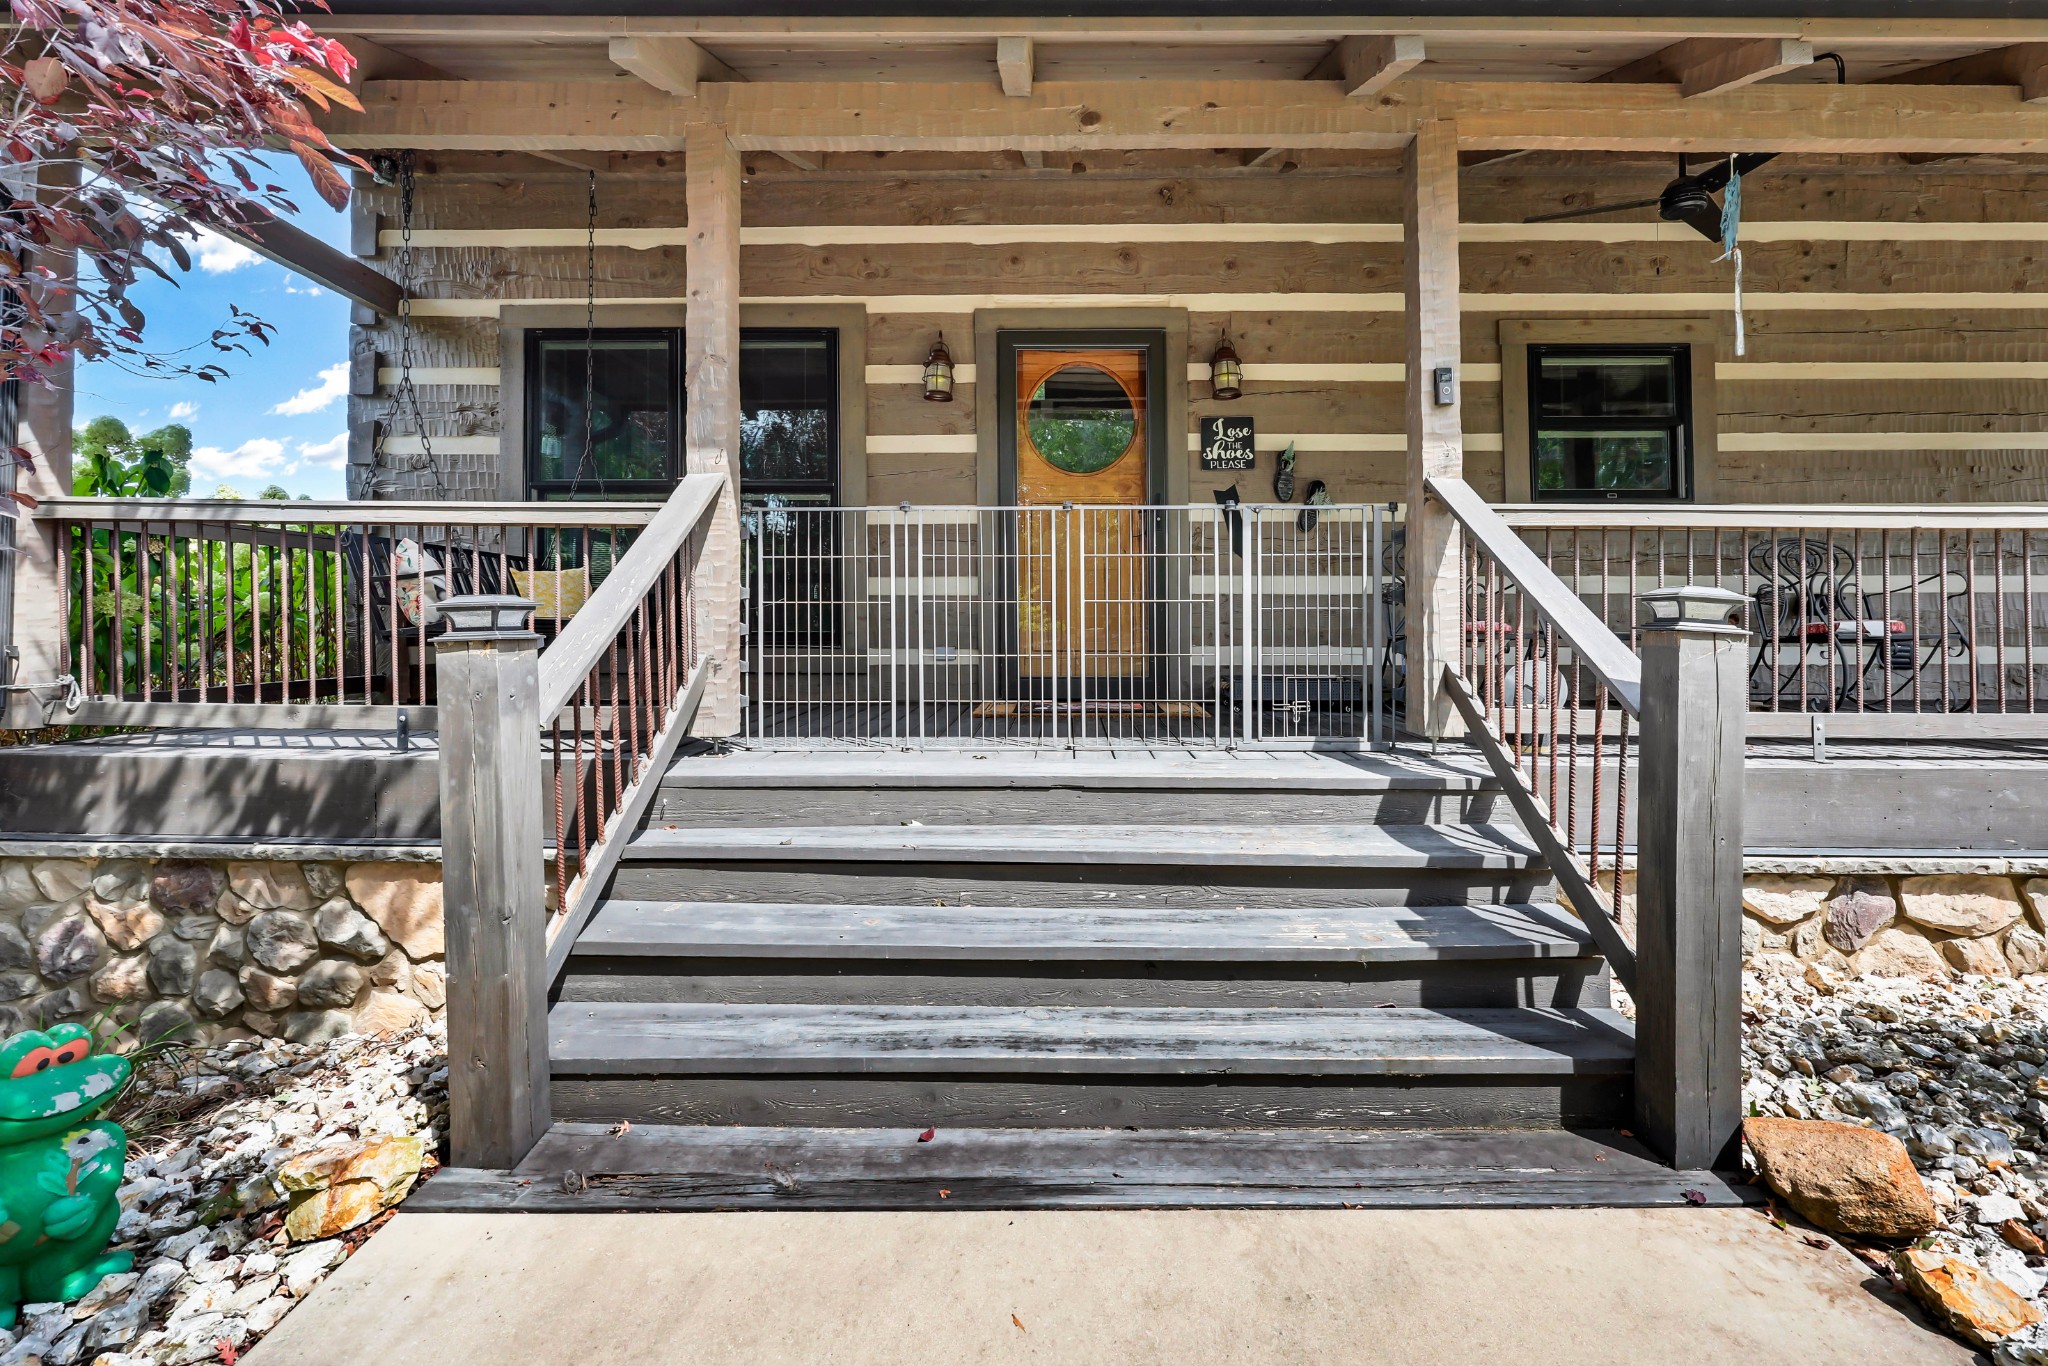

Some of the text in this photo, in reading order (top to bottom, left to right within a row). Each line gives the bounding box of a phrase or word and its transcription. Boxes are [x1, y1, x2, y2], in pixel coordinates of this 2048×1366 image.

[1212, 418, 1251, 441] Lose
[1203, 440, 1253, 459] shoes
[1210, 460, 1246, 468] PLEASE
